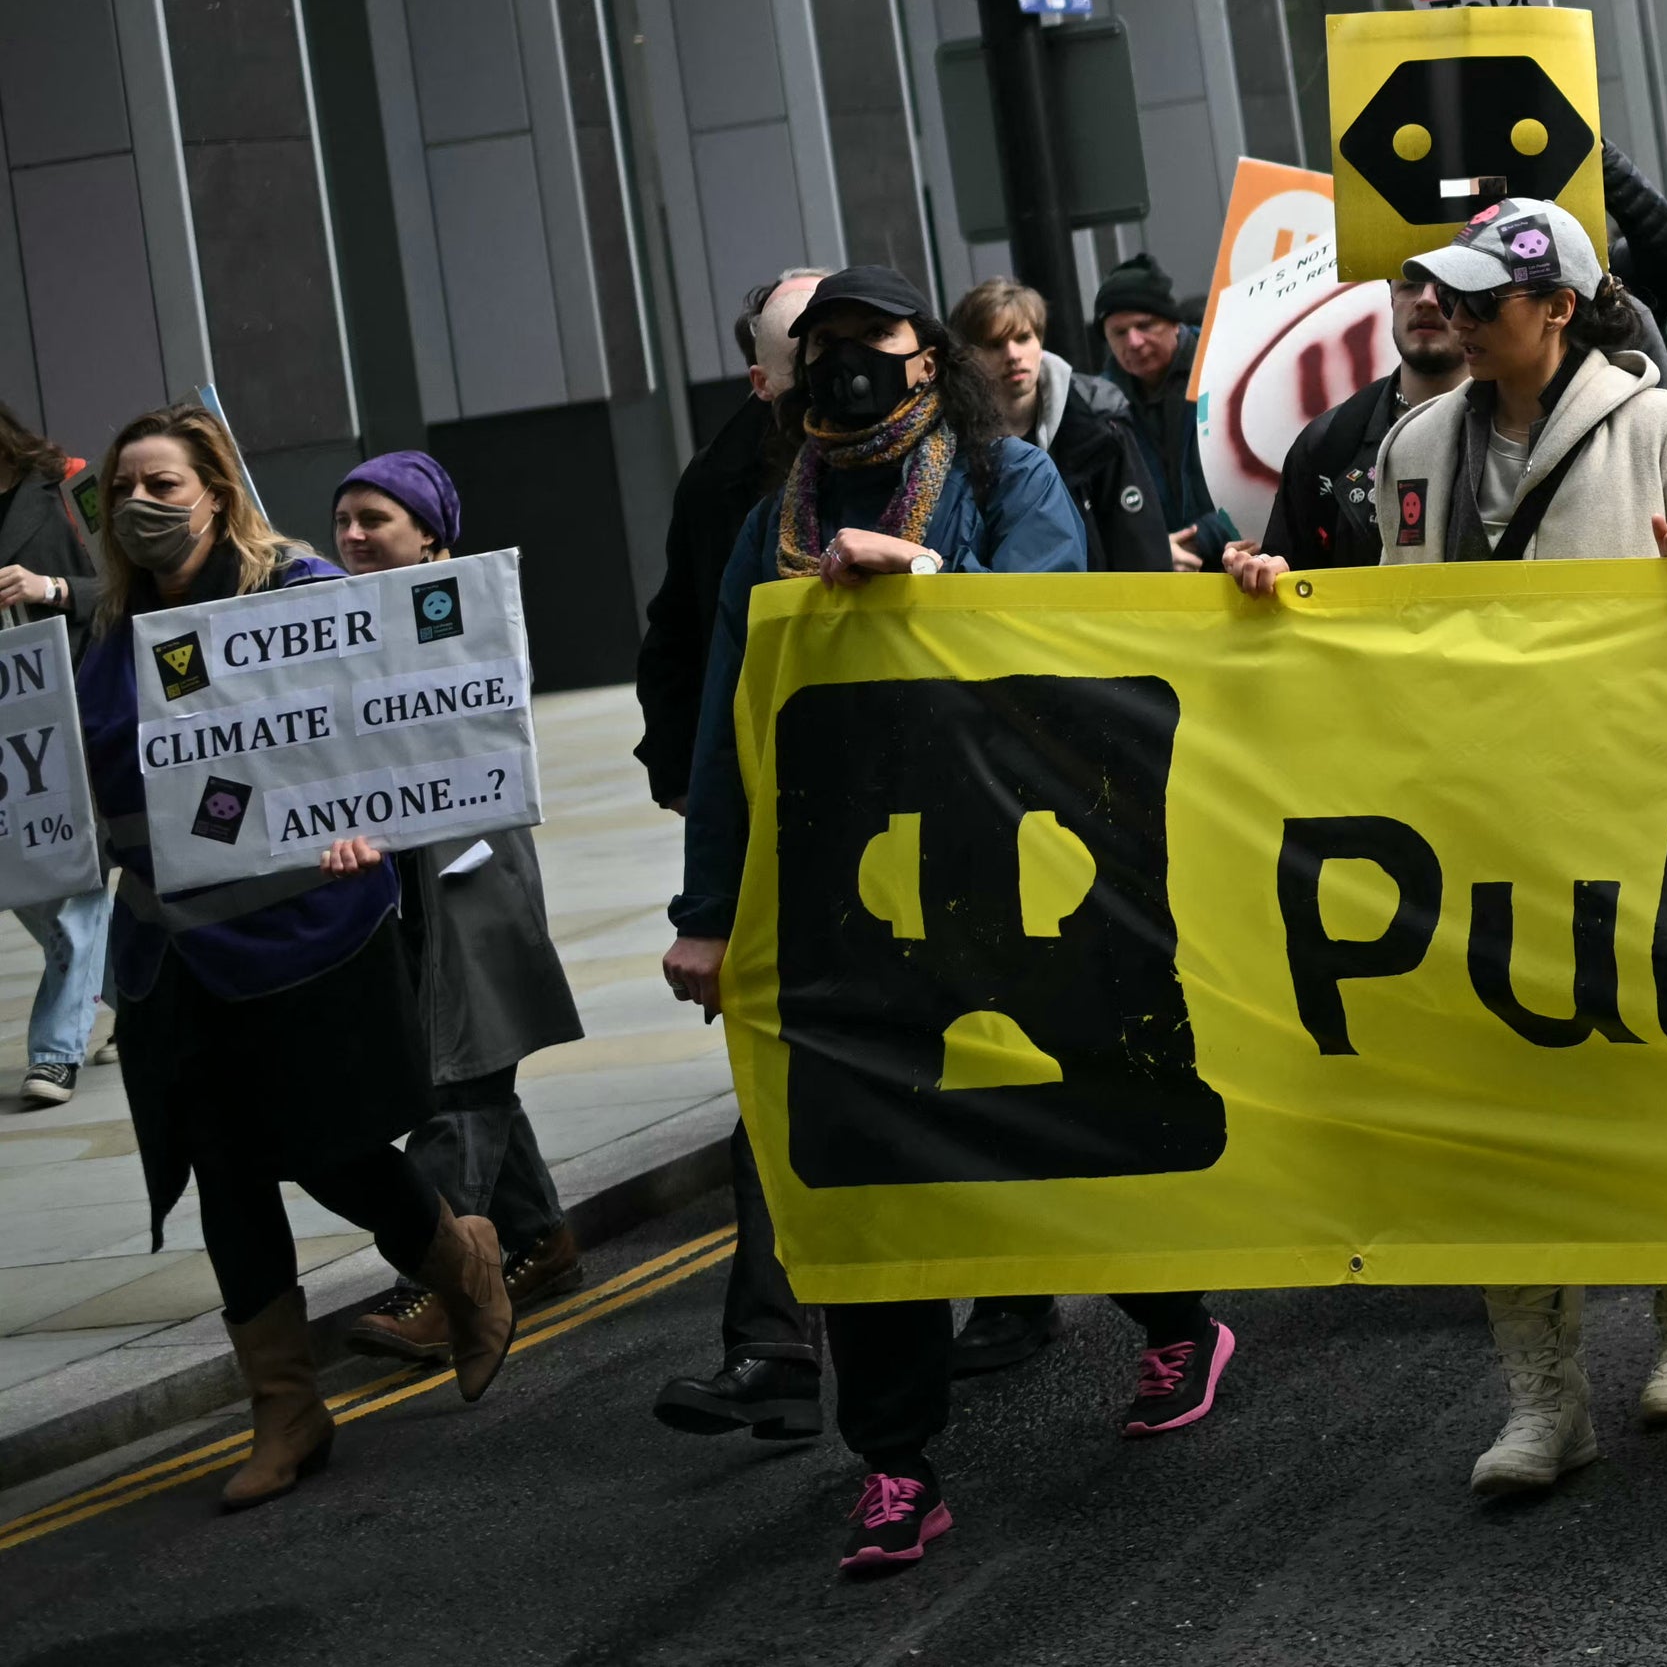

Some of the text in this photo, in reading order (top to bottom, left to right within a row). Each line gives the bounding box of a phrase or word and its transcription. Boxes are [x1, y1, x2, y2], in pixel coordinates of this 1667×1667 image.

[1276, 258, 1338, 298] TO REG
[1297, 242, 1331, 269] NOT
[224, 610, 376, 667] CYBER
[146, 677, 514, 768] CLIMATE CHANGE,
[281, 769, 506, 842] ANYONE...?
[23, 813, 73, 847] 1%
